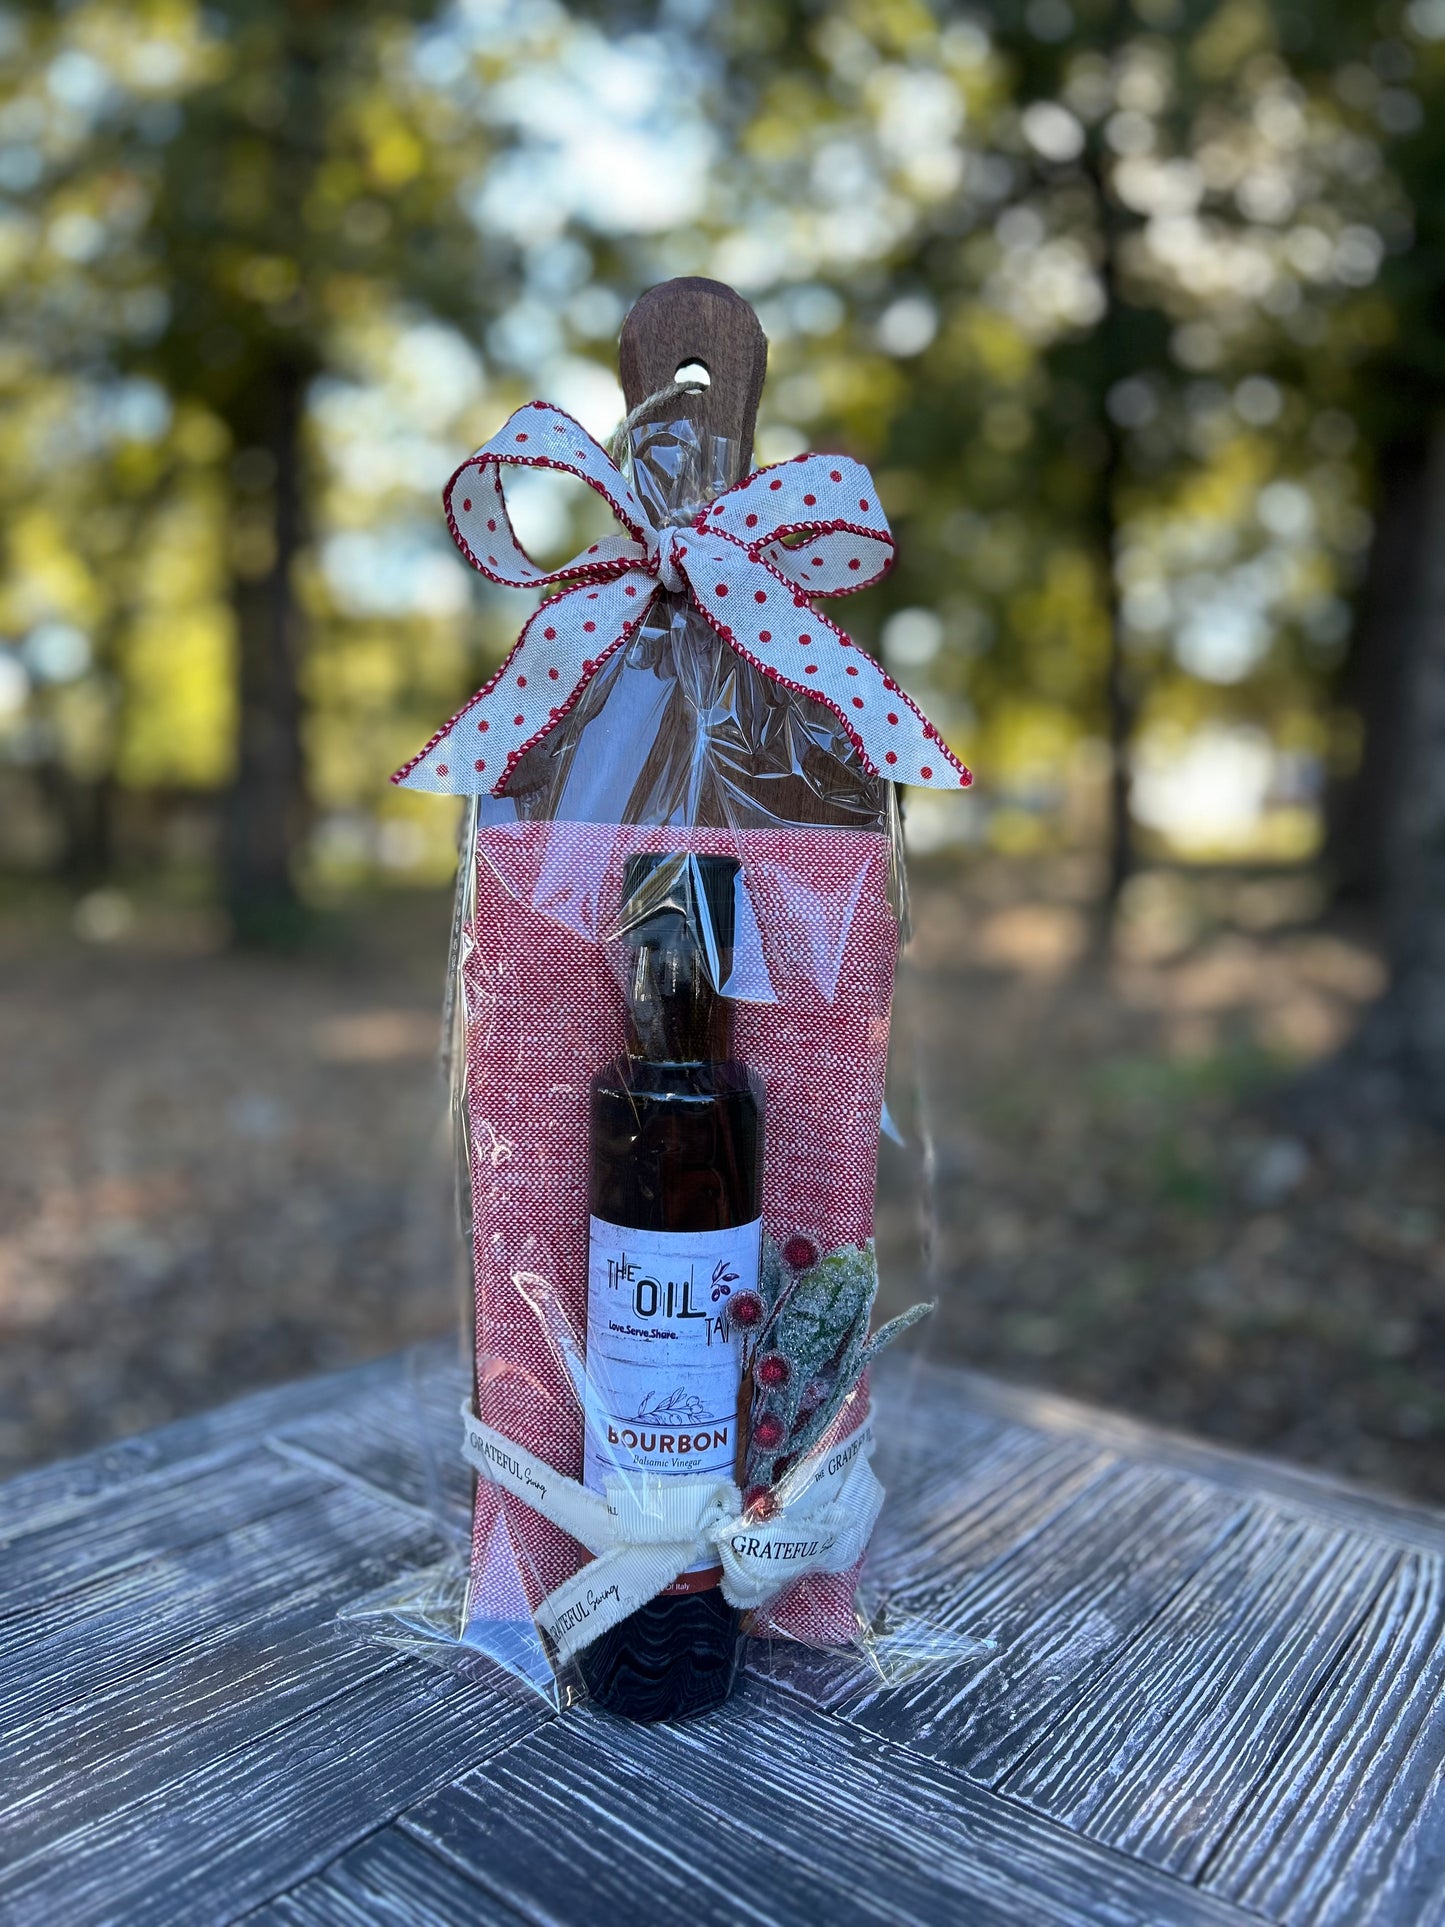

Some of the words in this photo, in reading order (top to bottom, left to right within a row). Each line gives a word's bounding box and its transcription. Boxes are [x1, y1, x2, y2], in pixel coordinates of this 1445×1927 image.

[607, 1252, 642, 1290] THE
[632, 1264, 707, 1321] OIL
[607, 1424, 728, 1454] BOURBON
[470, 1432, 523, 1481] GRATEFUL
[633, 1454, 669, 1467] Balsamic
[671, 1457, 702, 1469] Vinegar
[731, 1535, 819, 1560] GRATEFUL
